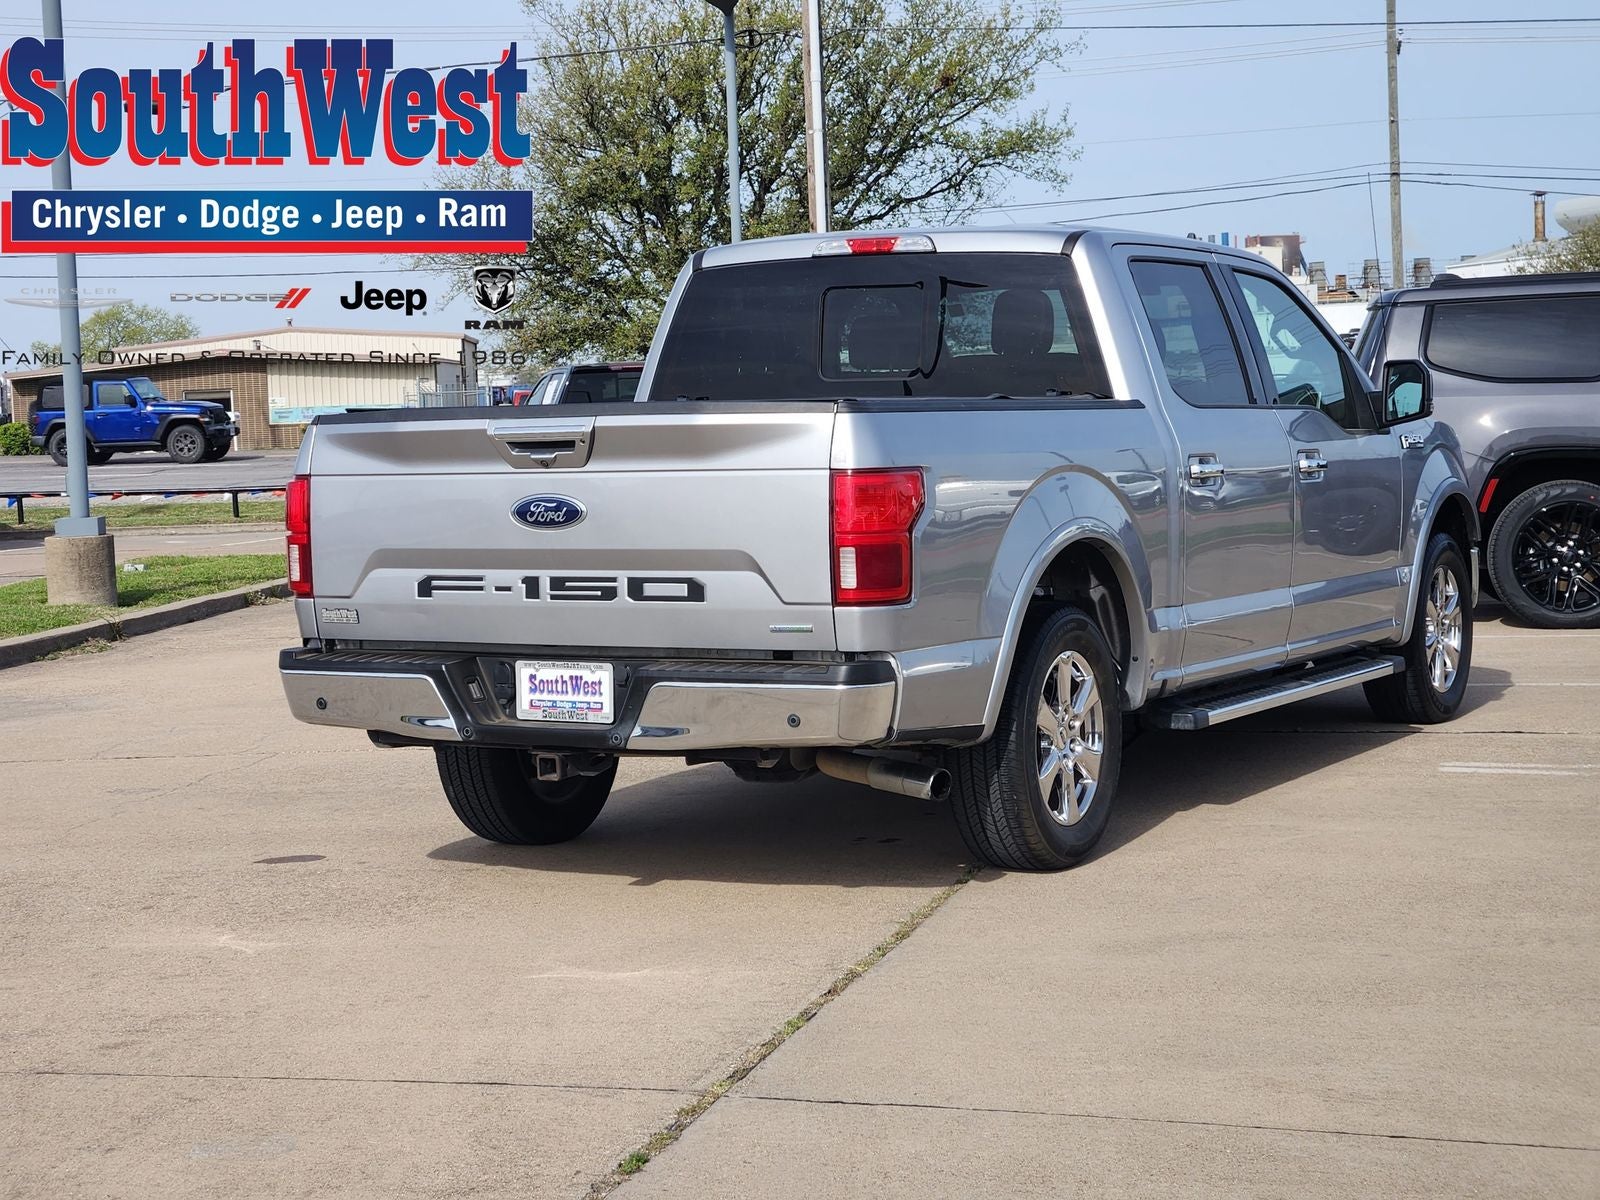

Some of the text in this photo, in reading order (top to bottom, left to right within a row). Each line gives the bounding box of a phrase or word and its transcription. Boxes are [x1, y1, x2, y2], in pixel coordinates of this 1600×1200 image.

[526, 501, 567, 524] Ford
[416, 575, 706, 603] F-150
[528, 673, 603, 697] SouthWest
[532, 700, 553, 709] Chrysler
[556, 700, 573, 709] Dodge
[542, 709, 588, 721] SouthWest
